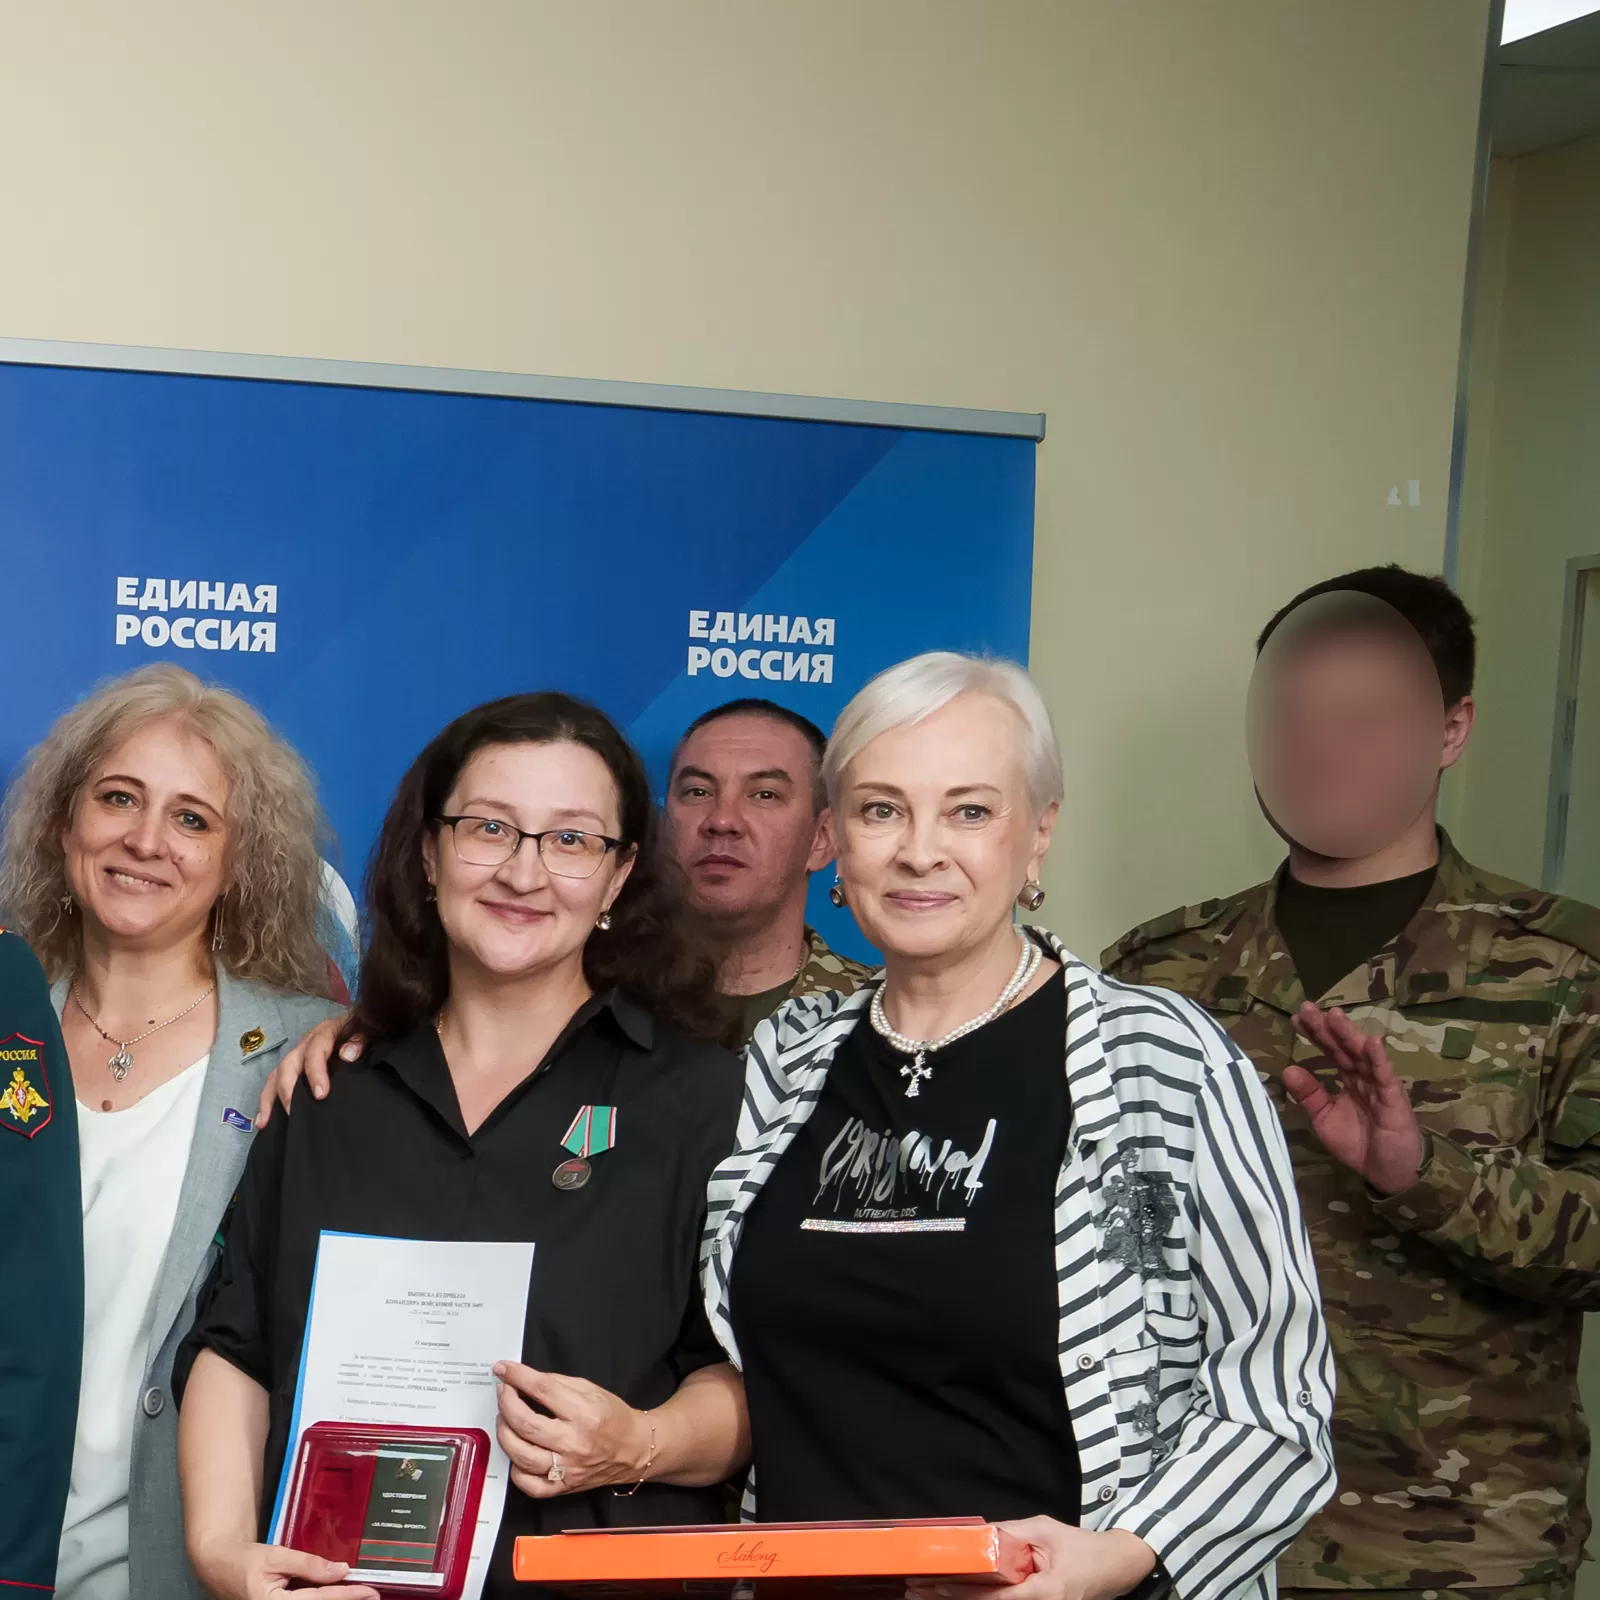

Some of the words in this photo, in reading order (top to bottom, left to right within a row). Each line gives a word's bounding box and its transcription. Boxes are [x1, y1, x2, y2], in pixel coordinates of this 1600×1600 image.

[116, 577, 277, 613] ЕДИНАЯ
[116, 614, 276, 652] РОССИЯ
[689, 610, 835, 645] ЕДИНАЯ
[688, 646, 833, 683] РОССИЯ
[854, 1208, 899, 1219] AUTHENTIC
